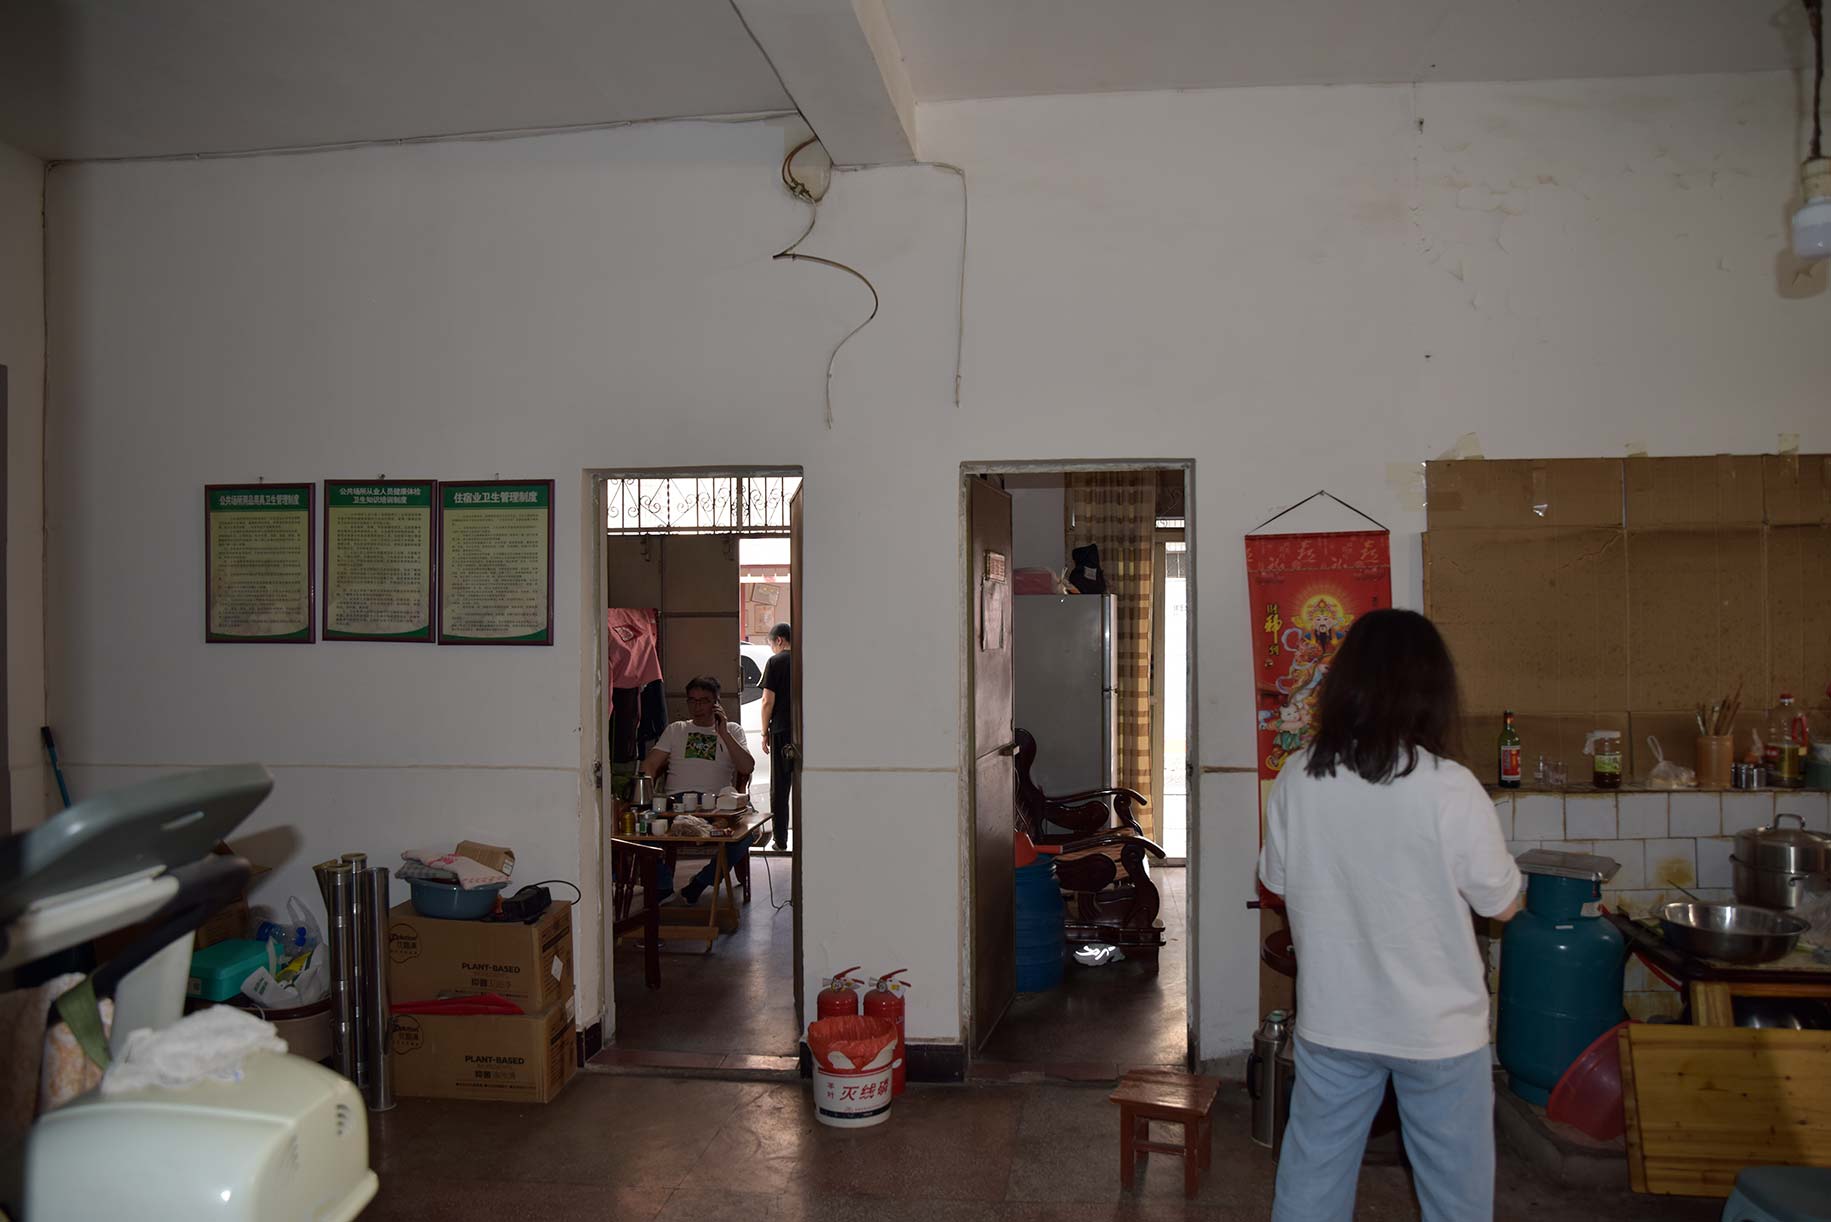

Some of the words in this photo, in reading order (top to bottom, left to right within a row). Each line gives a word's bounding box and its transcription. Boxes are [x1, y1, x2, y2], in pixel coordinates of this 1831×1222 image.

[453, 490, 539, 504] 住宿业卫生管理制度
[462, 962, 521, 974] PLANT-BASED
[464, 1055, 525, 1065] PLANT-BASED
